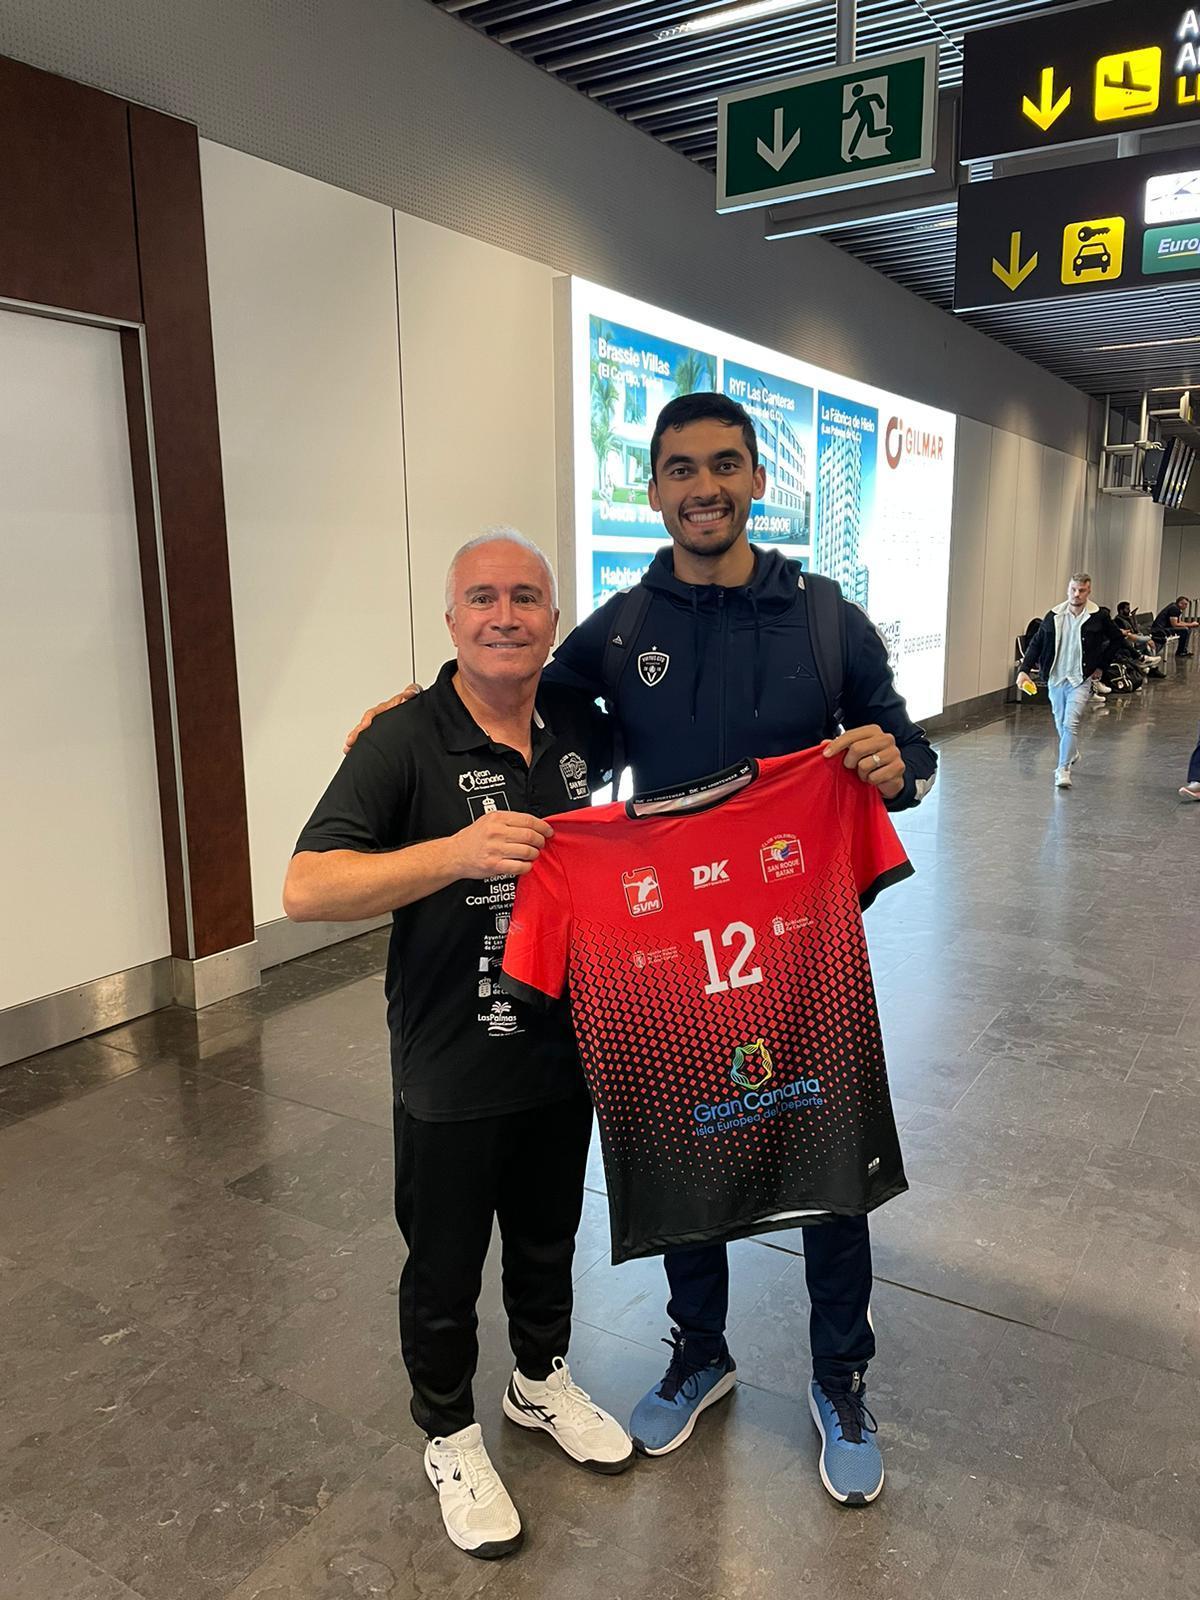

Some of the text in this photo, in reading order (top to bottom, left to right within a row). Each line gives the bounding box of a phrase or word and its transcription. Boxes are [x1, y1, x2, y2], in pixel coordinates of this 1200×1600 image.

[1178, 8, 1200, 40] A
[1157, 237, 1200, 254] Euro
[598, 336, 670, 377] Brassie Villas
[729, 377, 795, 411] RYF Las Canteras
[821, 405, 830, 421] La
[852, 415, 861, 429] de
[905, 427, 944, 461] GILMAR
[475, 774, 505, 785] Canaria
[690, 859, 730, 886] DK
[767, 858, 800, 873] SAN ROQUE
[775, 867, 795, 878] BATAN
[465, 891, 516, 906] Canarias
[490, 882, 516, 895] Islas
[633, 899, 660, 915] SVM
[693, 921, 764, 995] 12
[693, 1076, 820, 1123] Gran Canaria
[695, 1096, 824, 1136] Isla Europea del Deporte
